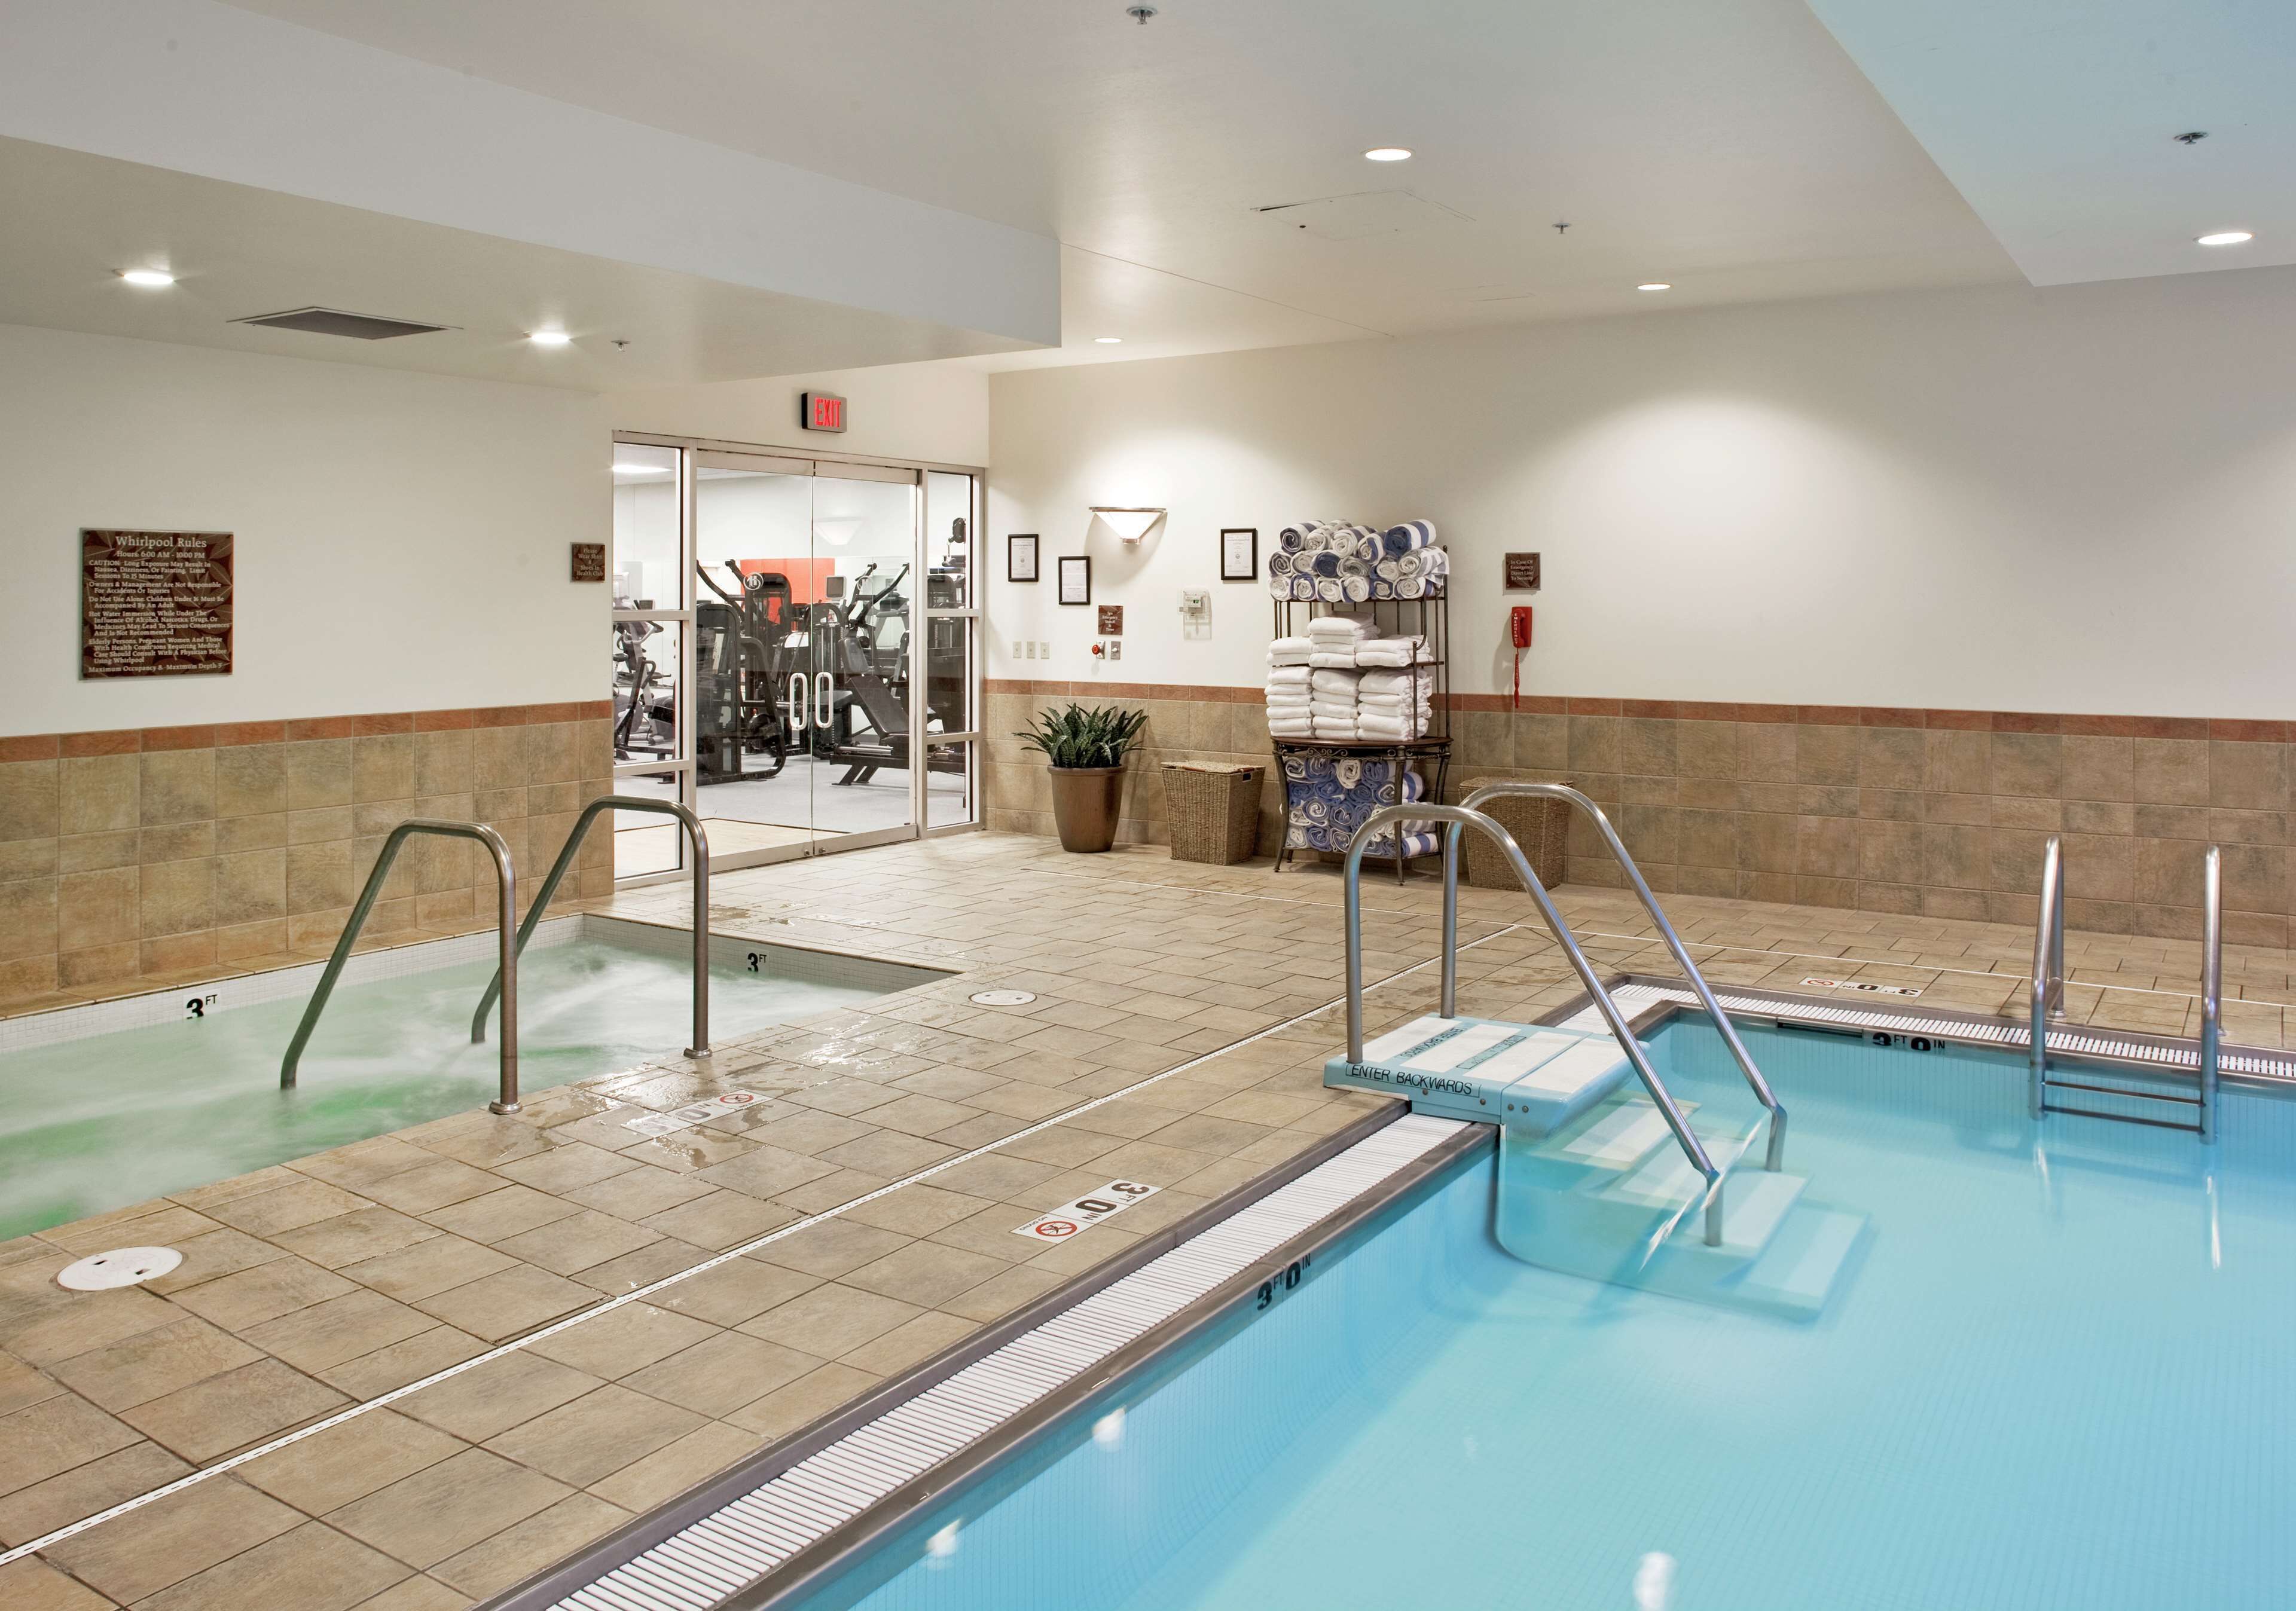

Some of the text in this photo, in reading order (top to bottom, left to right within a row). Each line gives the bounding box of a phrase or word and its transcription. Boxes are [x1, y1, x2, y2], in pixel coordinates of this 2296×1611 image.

[815, 398, 841, 427] EXIT
[115, 536, 207, 549] Whirlpool Rules
[747, 952, 767, 973] 3 FT
[187, 994, 218, 1020] 3 FT
[1894, 1035, 1907, 1044] FT
[1934, 1040, 1945, 1048] IN
[1351, 1064, 1473, 1095] ENTER BACKWARDS
[1111, 1182, 1150, 1195] 3
[1075, 1199, 1117, 1213] 0
[1119, 1194, 1137, 1202] FT
[1257, 1253, 1311, 1311] 3 FT 0 IN
